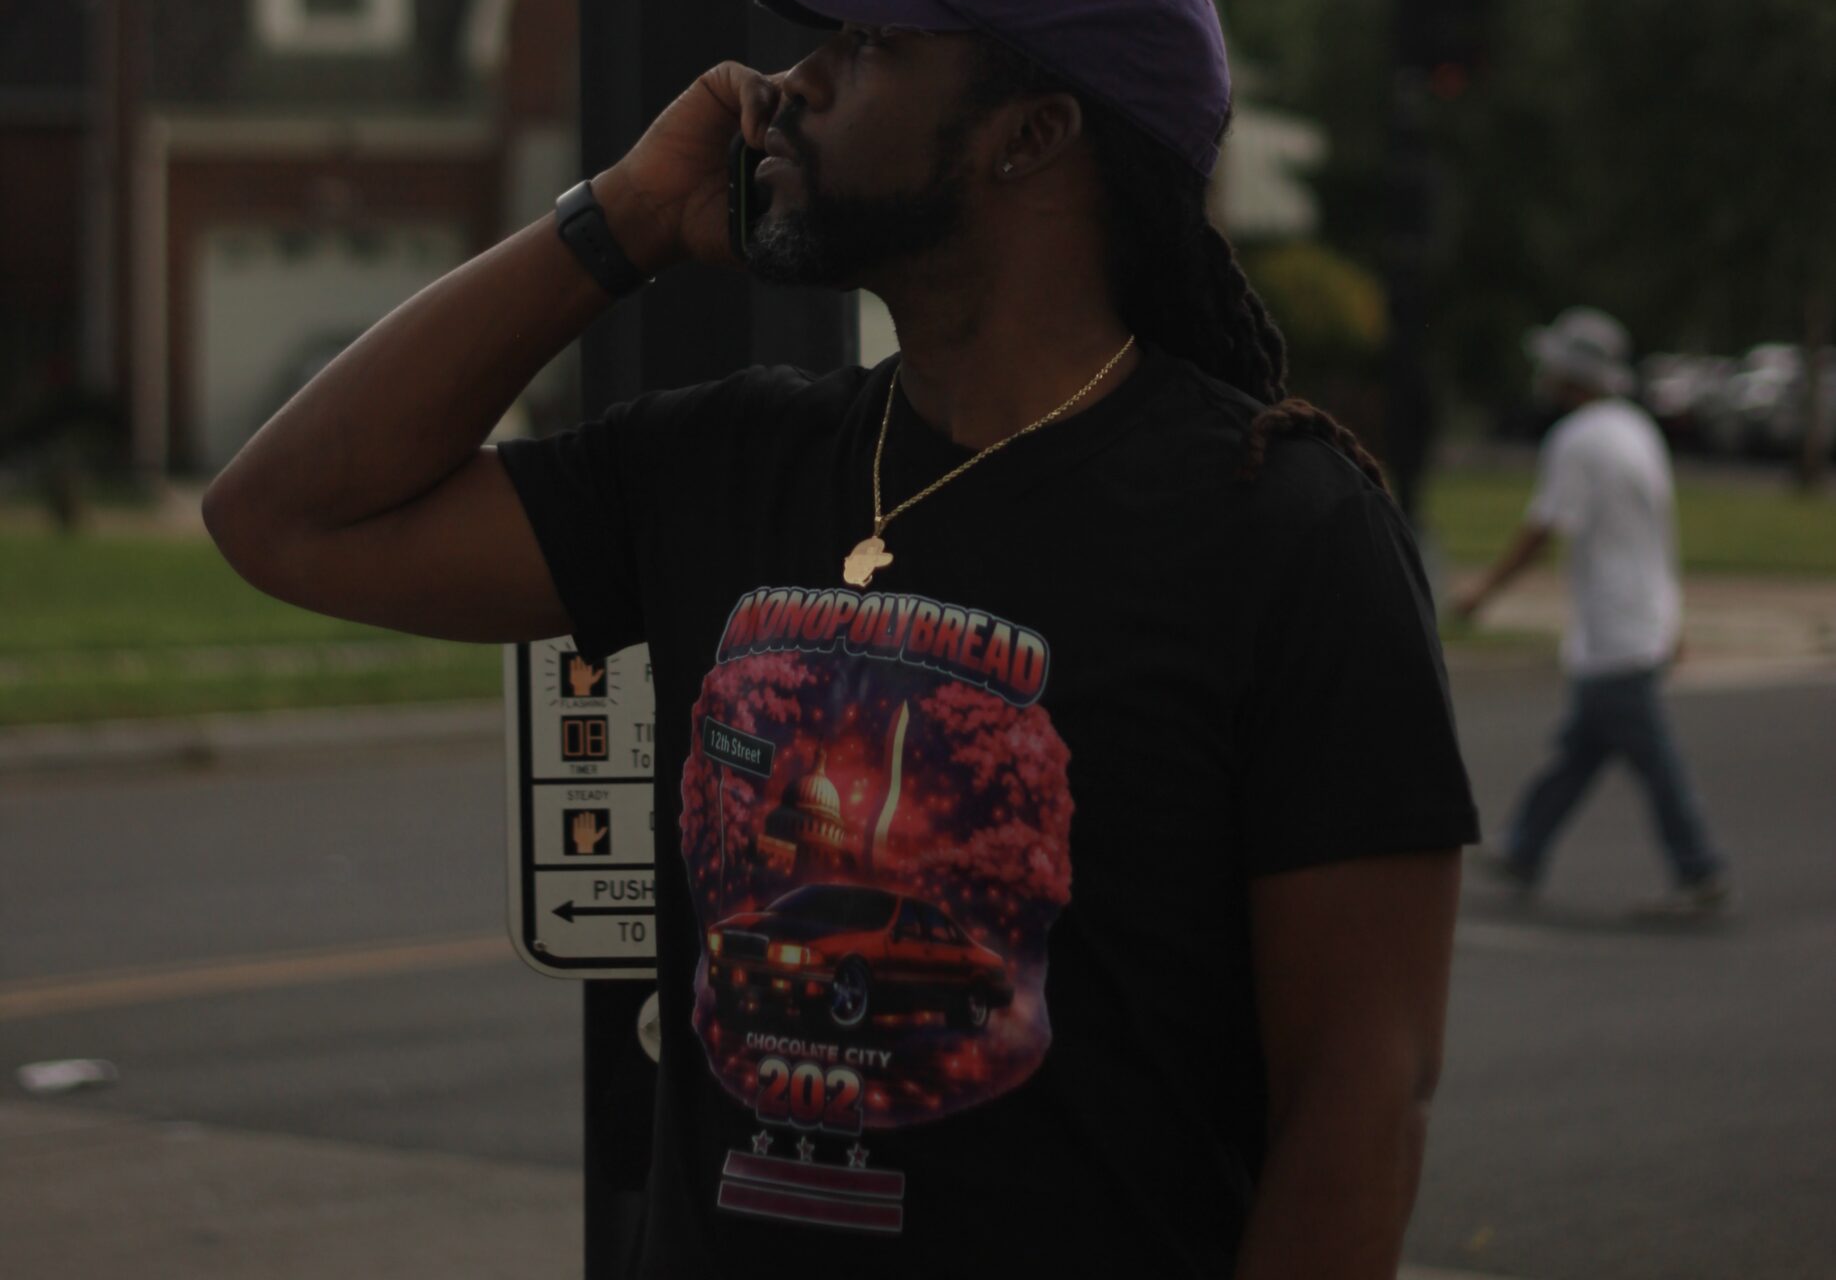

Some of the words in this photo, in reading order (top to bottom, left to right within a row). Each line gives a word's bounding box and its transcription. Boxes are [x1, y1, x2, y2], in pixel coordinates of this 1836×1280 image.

[731, 736, 761, 764] Street
[567, 789, 609, 801] STEADY
[617, 921, 646, 943] TO
[745, 1031, 840, 1061] CHOCOLATE
[844, 1047, 892, 1068] CITY
[758, 1057, 861, 1132] 202
